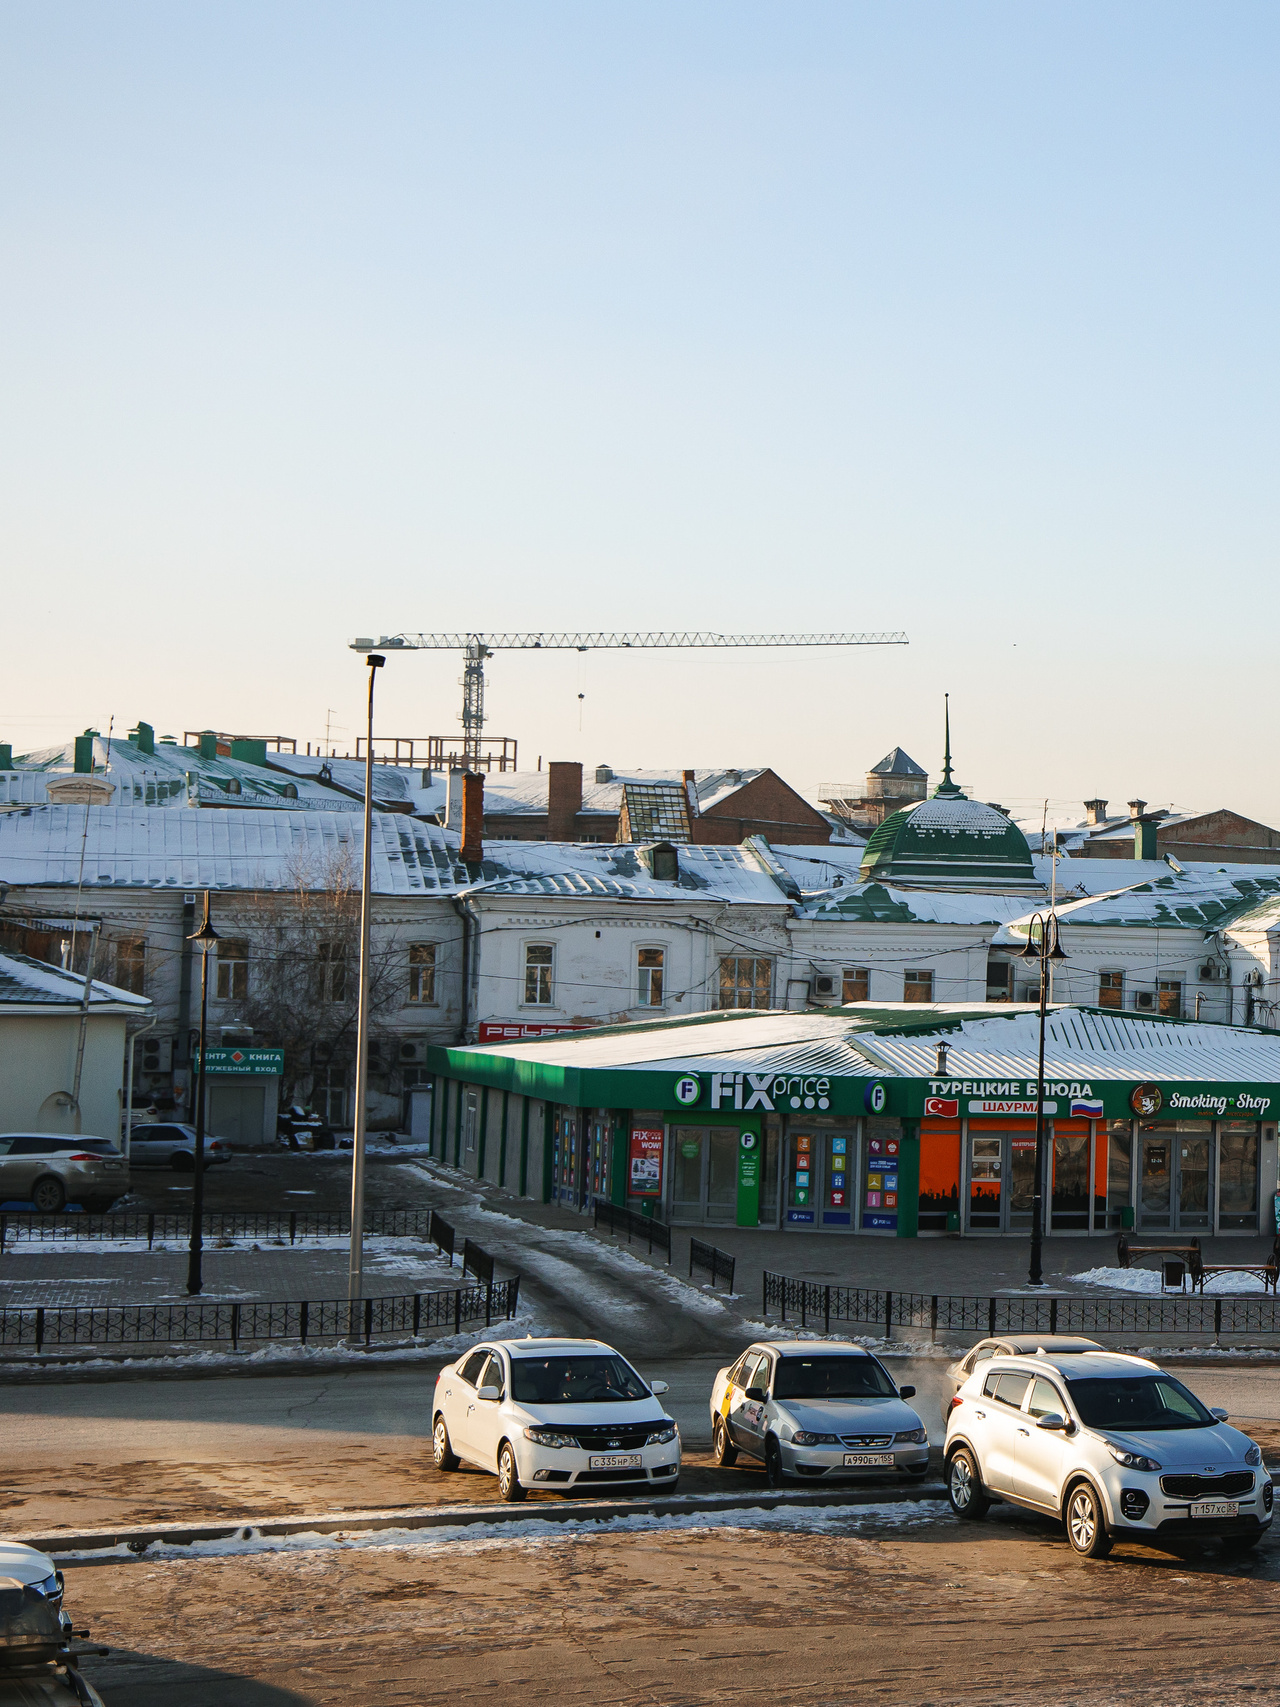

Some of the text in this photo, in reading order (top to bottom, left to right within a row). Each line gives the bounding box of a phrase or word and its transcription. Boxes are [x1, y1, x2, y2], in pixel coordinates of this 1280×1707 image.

[249, 1053, 281, 1061] КНИГА
[773, 1077, 831, 1099] price
[928, 1081, 1020, 1097] ТУРЕЦКИЕ
[1169, 1092, 1271, 1115] Smoking Shop
